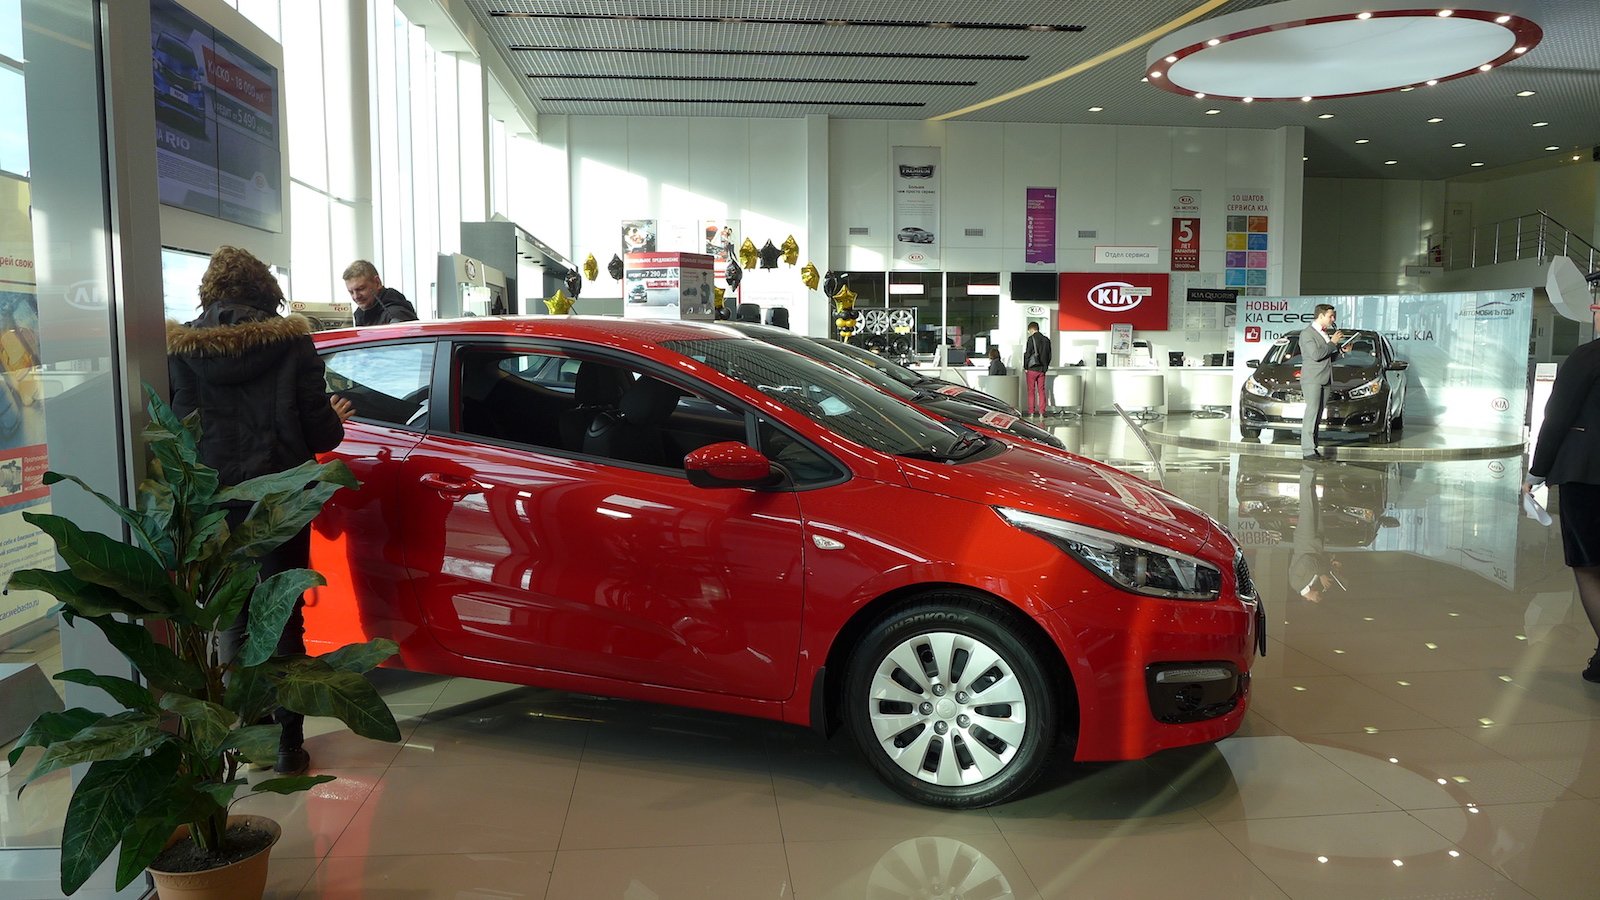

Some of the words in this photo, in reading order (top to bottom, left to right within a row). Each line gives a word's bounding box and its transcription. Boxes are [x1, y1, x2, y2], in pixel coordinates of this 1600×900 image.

[1227, 204, 1255, 212] СЕРВИСА
[1178, 220, 1193, 243] 5
[1105, 251, 1124, 259] Отдел
[0, 255, 14, 267] рей
[14, 257, 34, 269] свою
[1097, 289, 1133, 305] KIA
[1245, 299, 1288, 311] НОВЫЙ
[1245, 313, 1264, 323] KIA
[1267, 313, 1315, 323] cee
[1414, 330, 1434, 341] KIA
